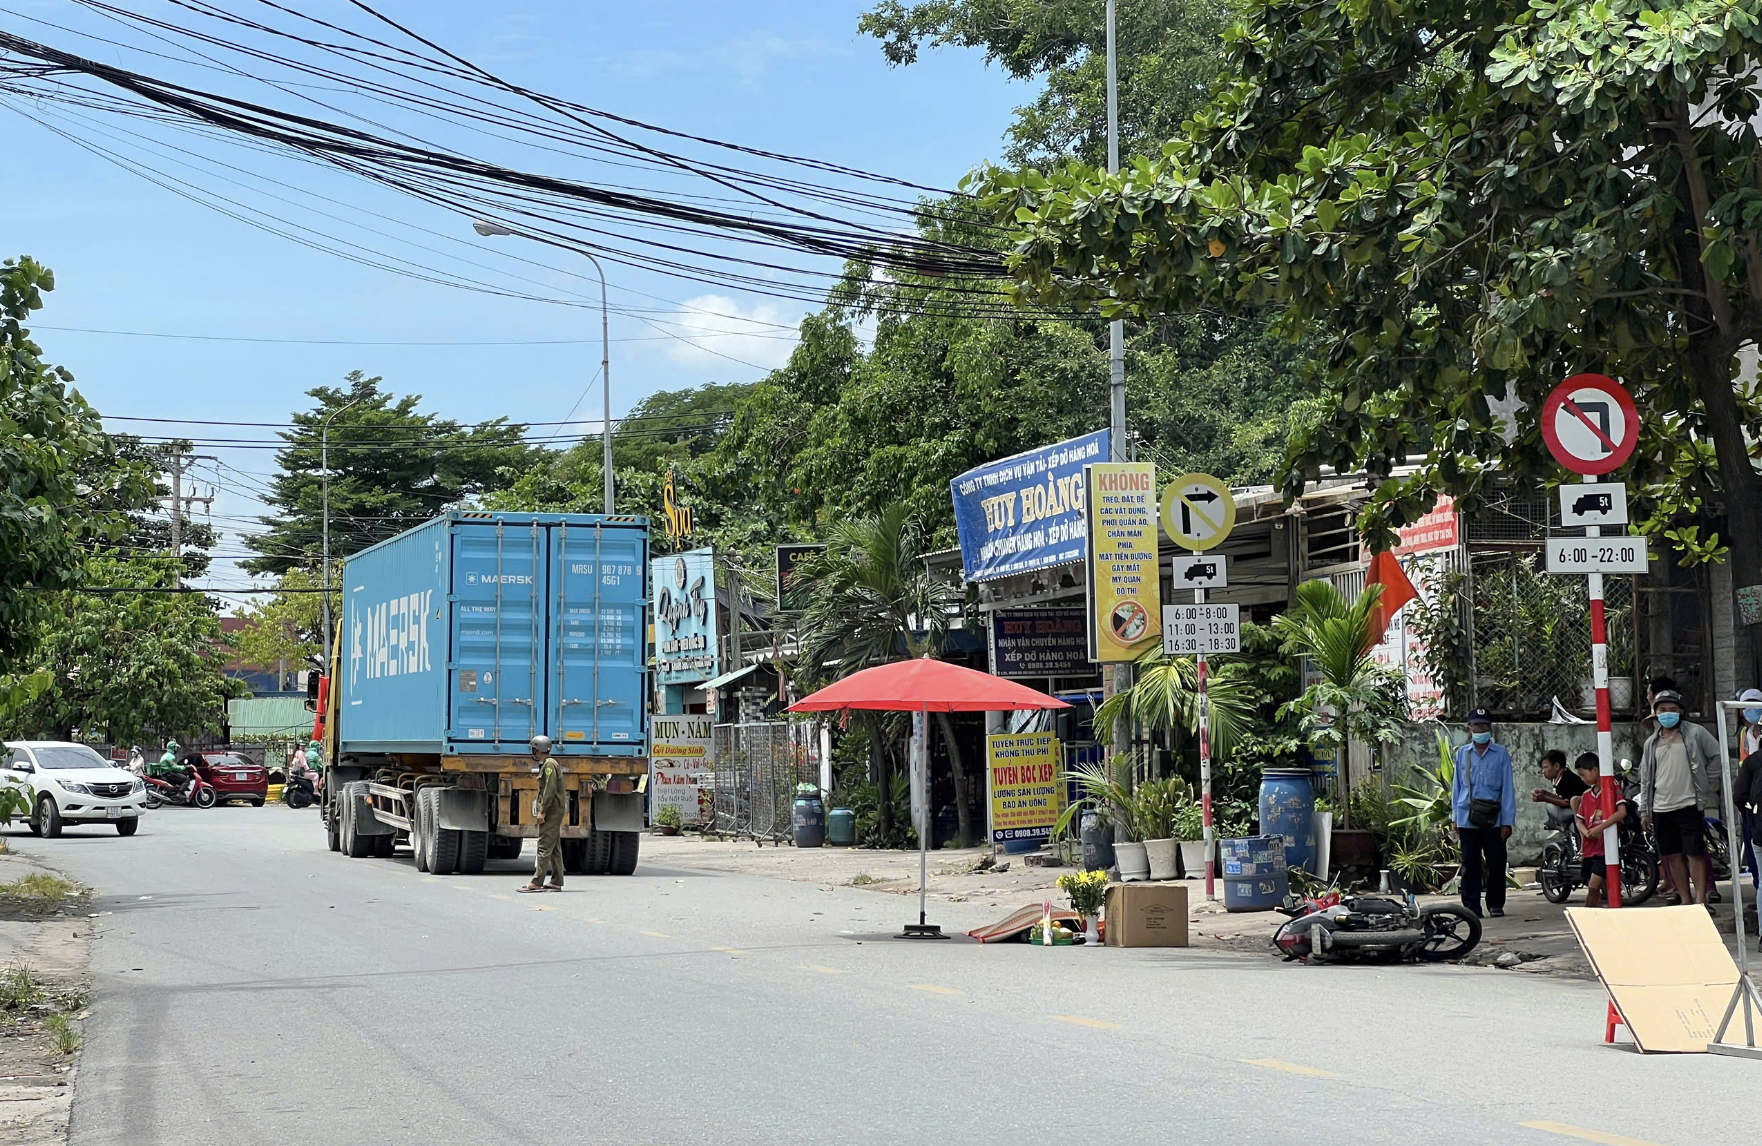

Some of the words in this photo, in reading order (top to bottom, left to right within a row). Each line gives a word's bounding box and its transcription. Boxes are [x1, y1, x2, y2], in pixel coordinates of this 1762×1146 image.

[960, 480, 976, 496] CÔNG
[974, 476, 983, 490] TY
[983, 473, 1000, 488] TNHH
[999, 467, 1014, 486] DỊCH
[1014, 465, 1022, 481] VỤ
[1022, 460, 1035, 479] VẬN
[1047, 450, 1060, 470] XẾP
[1060, 448, 1068, 466] DỠ
[1068, 446, 1086, 462] HÀNG
[1098, 470, 1150, 492] KHÔNG
[981, 491, 1017, 534] HUY
[1020, 471, 1085, 524] HOÀNG
[1599, 496, 1609, 506] 5t
[664, 484, 692, 549] Spa
[1016, 530, 1033, 552] HÀNG
[1048, 518, 1060, 545] XẾP
[789, 550, 816, 562] CAFÉ
[1558, 548, 1587, 564] 6:00
[1599, 547, 1635, 562] 22:00
[572, 564, 592, 574] MRSU
[602, 564, 616, 575] 907
[618, 566, 632, 575] 878
[1206, 565, 1214, 574] 5t
[482, 575, 533, 584] MAERSK
[602, 576, 620, 586] 45G1
[1175, 608, 1196, 620] 6:00
[1206, 607, 1228, 620] 8:00
[1004, 621, 1032, 634] HUY
[1035, 617, 1082, 633] HOÀNG
[1168, 623, 1196, 635] 11:00
[1208, 622, 1235, 634] 13:00
[366, 589, 432, 679] MAERSK
[998, 637, 1016, 650] NHẬN
[1017, 637, 1030, 649] VẬN
[1031, 634, 1056, 646] CHUYỂN
[1058, 636, 1074, 646] HÀNG
[1168, 639, 1196, 651] 16:30
[1209, 638, 1235, 650] 18:30
[1005, 650, 1022, 661] XẾP
[1025, 650, 1037, 661] DỠ
[1039, 650, 1063, 661] HÀNG
[1066, 648, 1085, 660] HOÁ
[654, 722, 680, 744] MỤN
[687, 716, 712, 738] NÁM
[992, 737, 1014, 748] TUYỂN
[1016, 738, 1034, 748] TRỰC
[688, 746, 703, 754] Sinh
[995, 748, 1019, 758] KHÔNG
[1037, 747, 1049, 755] PHÍ
[993, 759, 1018, 786] TUYỂN
[1020, 760, 1036, 784] BỐC
[1038, 758, 1053, 782] XẾP
[994, 789, 1015, 798] LƯƠNG
[1018, 786, 1031, 797] SẢN
[1033, 786, 1054, 797] LƯỢNG
[1003, 801, 1015, 809] BAO
[1028, 798, 1047, 806] UỐNG
[1015, 827, 1055, 837] 0908.39.545
